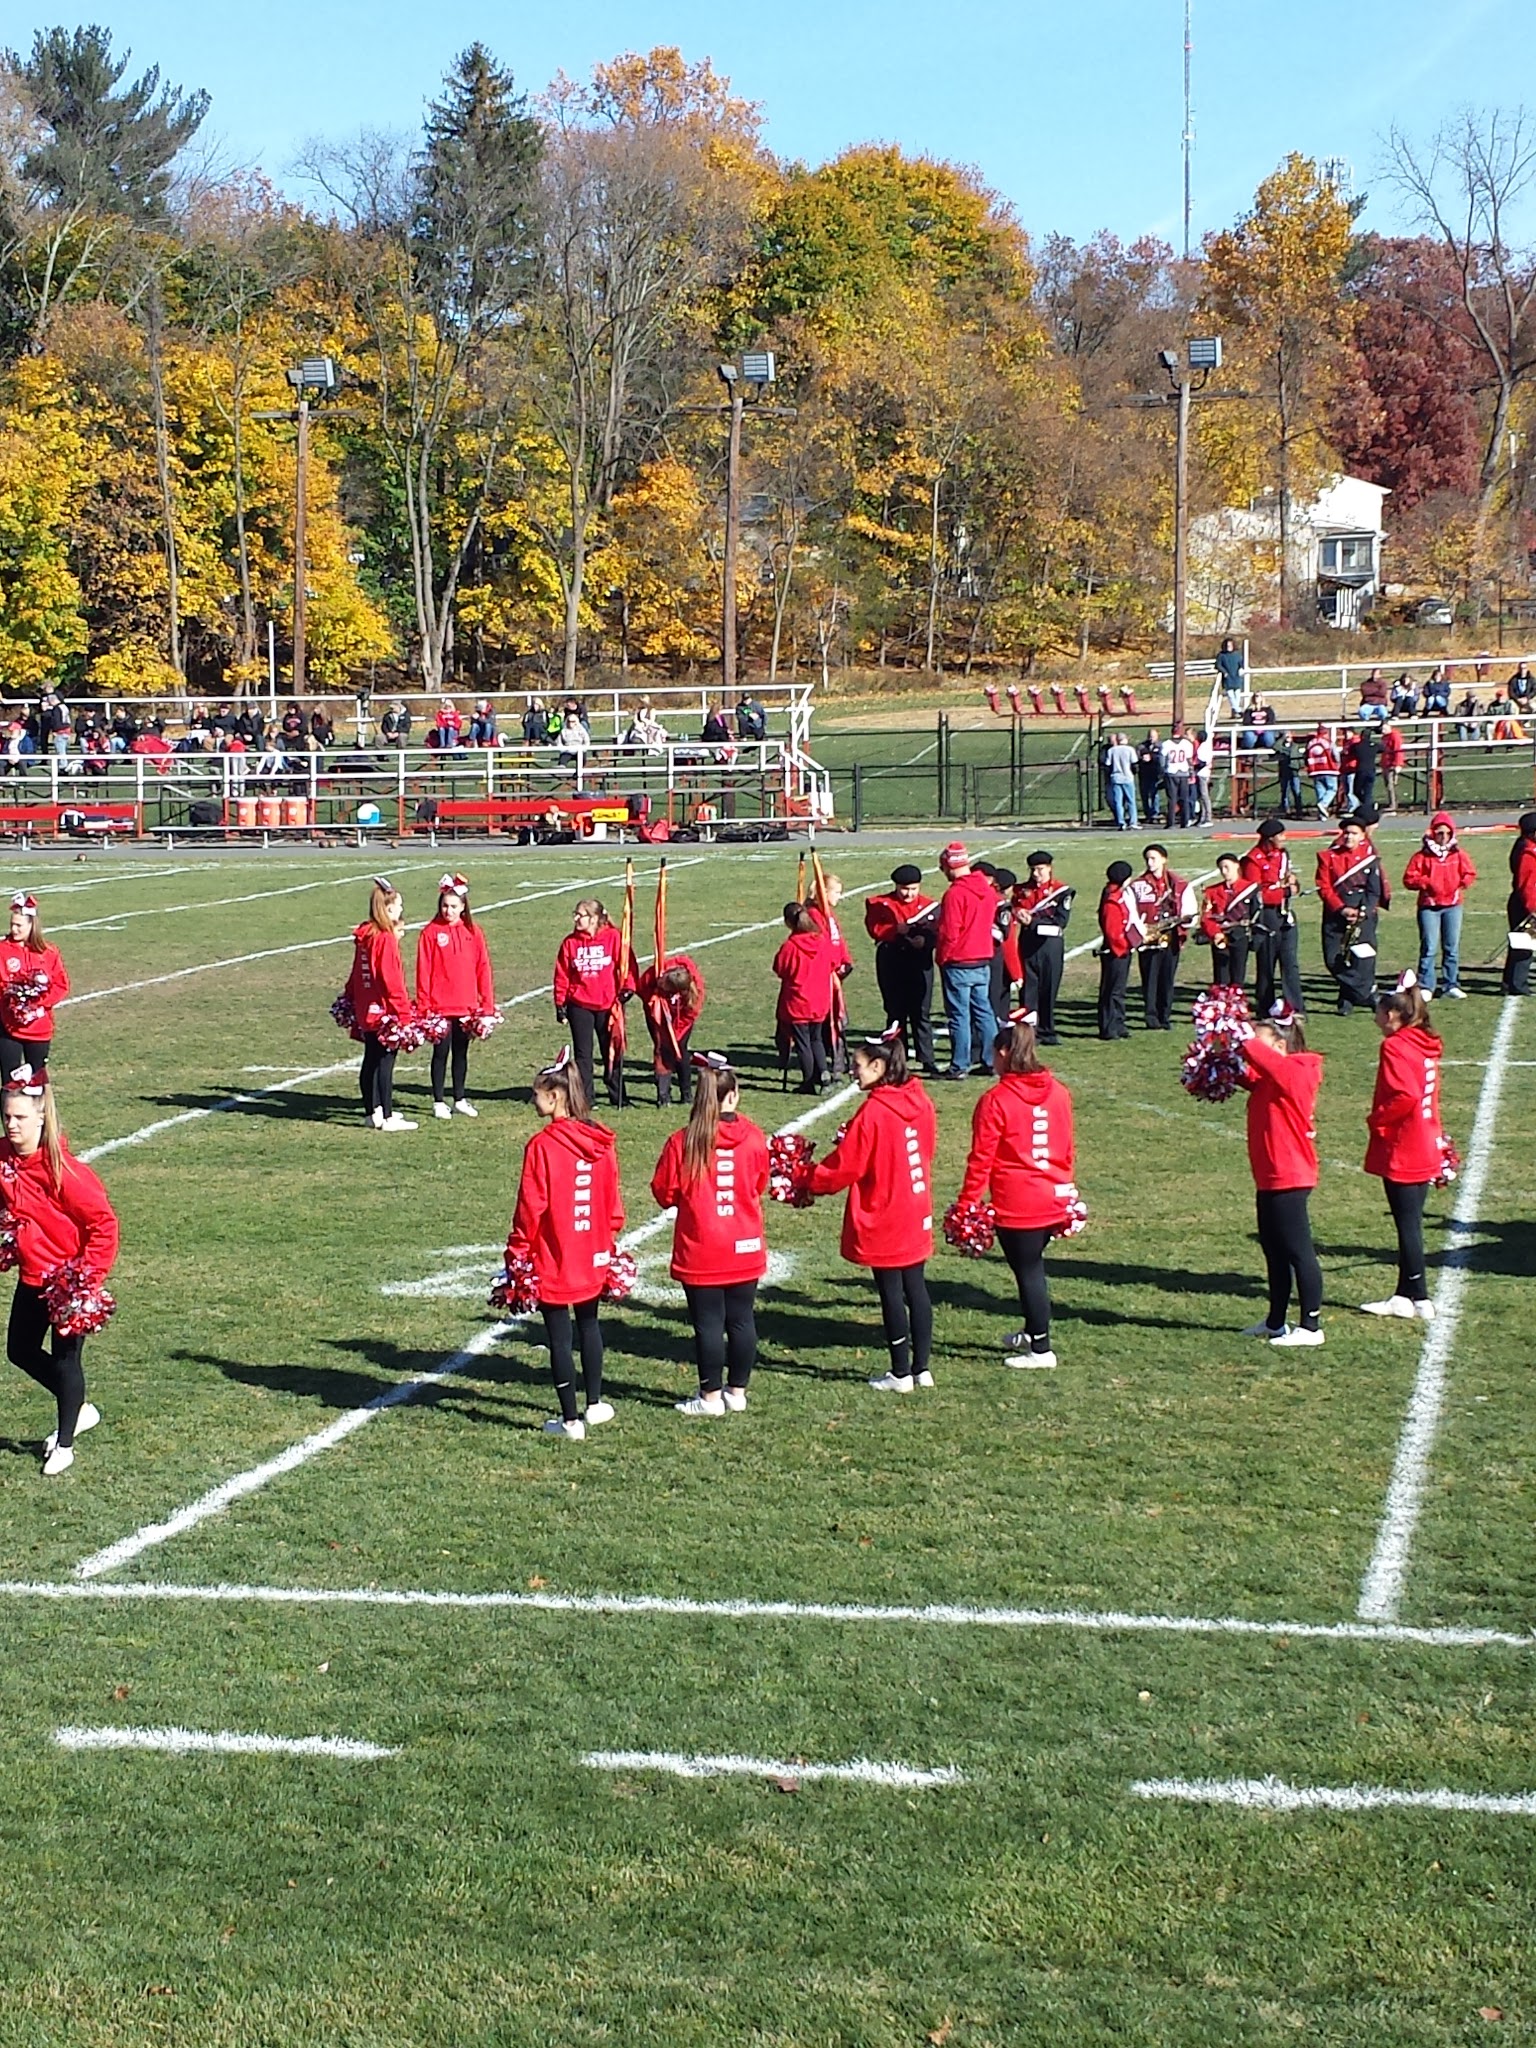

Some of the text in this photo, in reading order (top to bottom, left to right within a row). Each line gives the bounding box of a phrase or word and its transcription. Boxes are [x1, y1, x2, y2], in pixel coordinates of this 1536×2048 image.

[1170, 749, 1186, 763] 20
[573, 1158, 593, 1232] JONES
[904, 1126, 926, 1195] JONES
